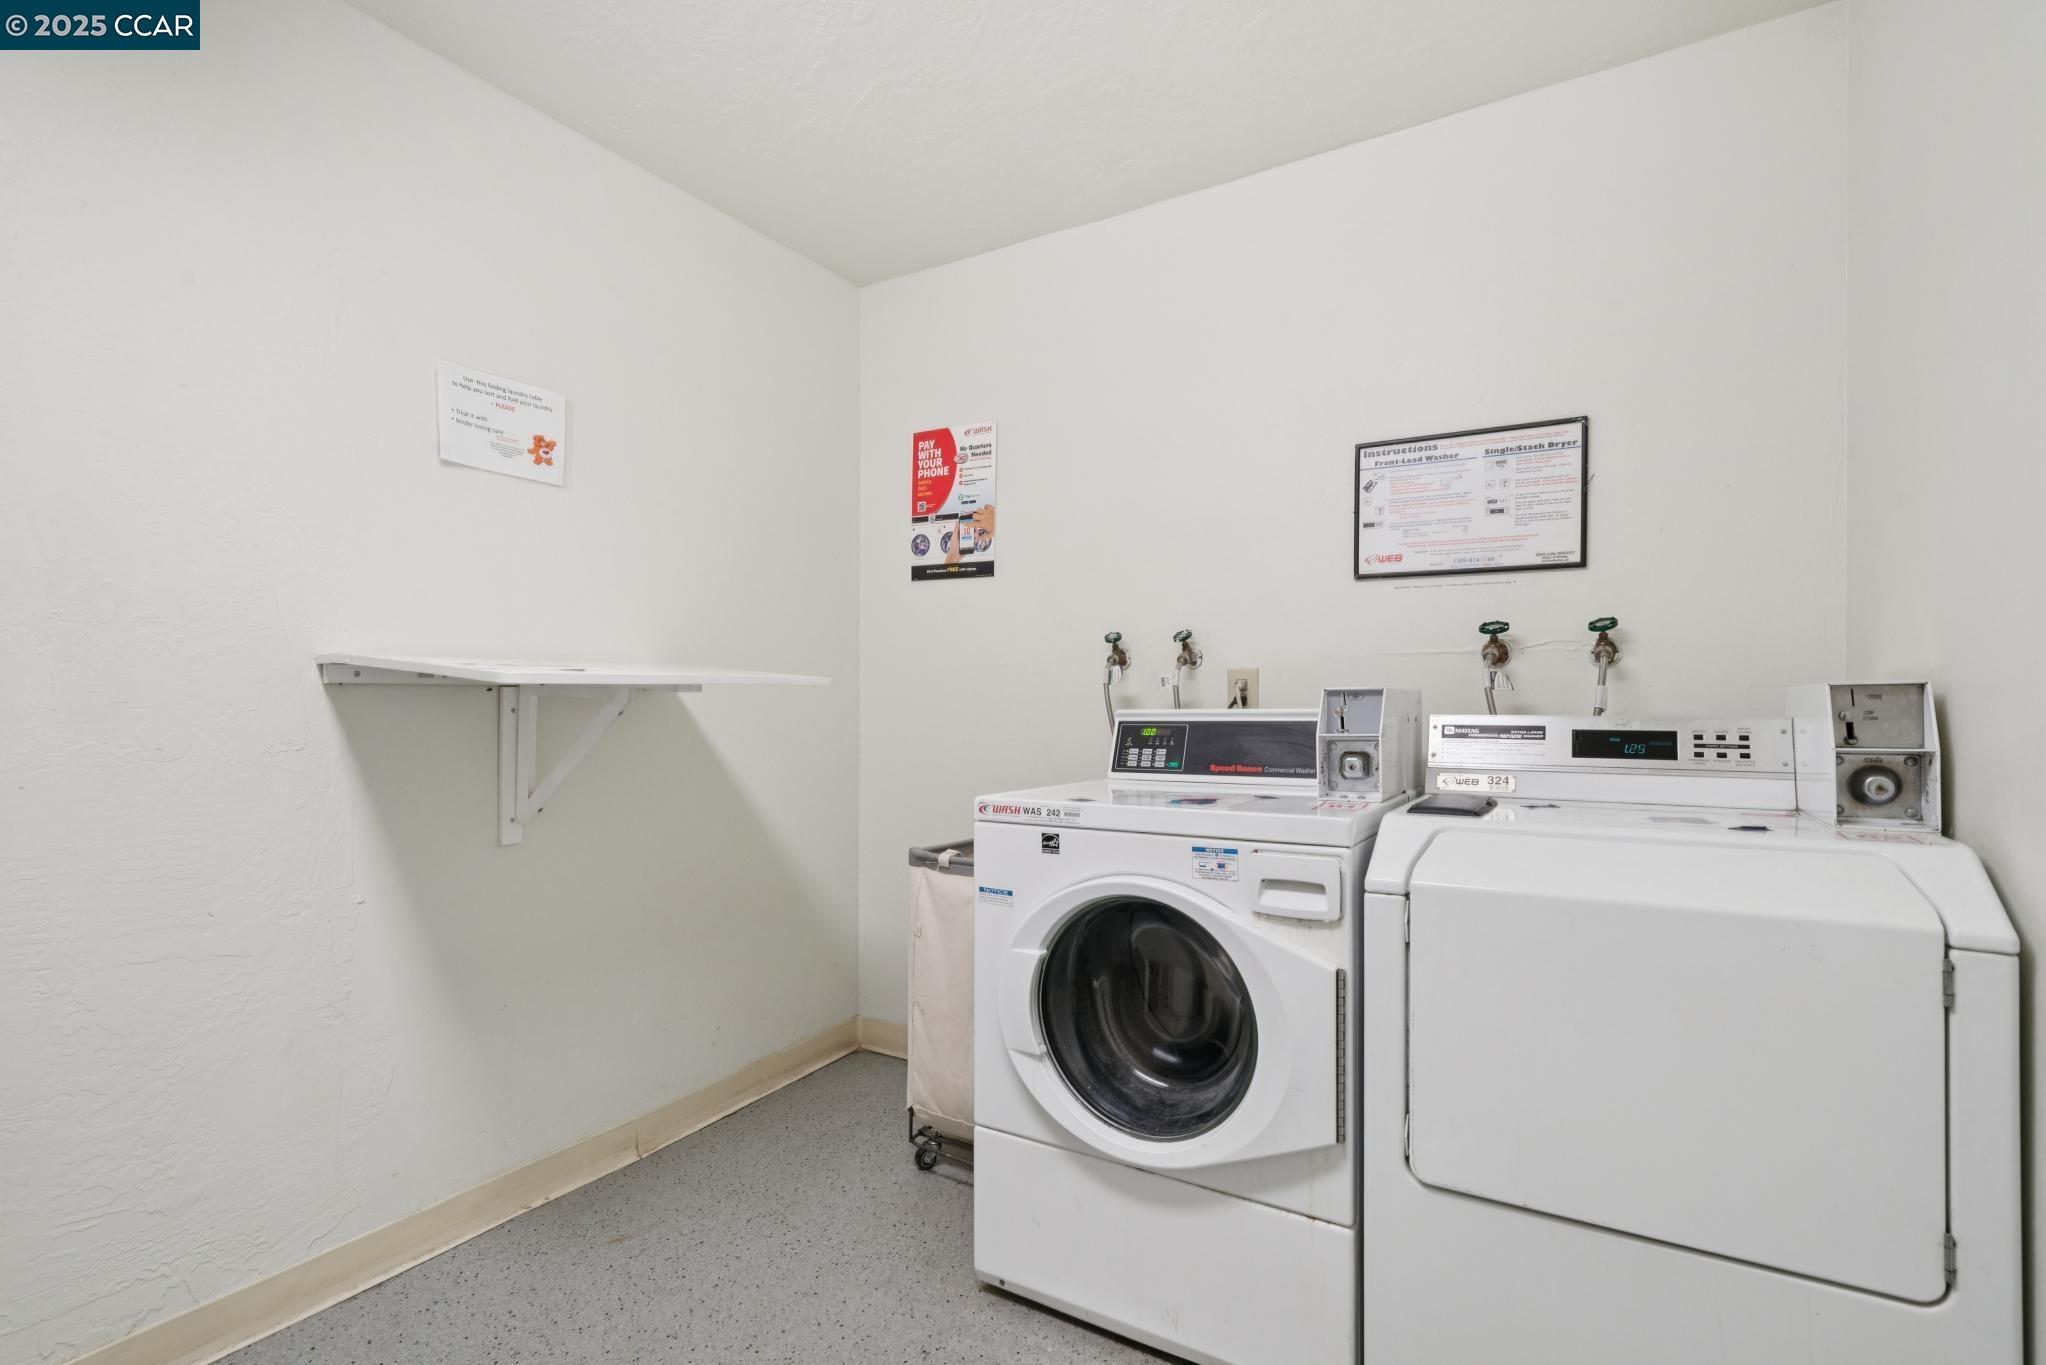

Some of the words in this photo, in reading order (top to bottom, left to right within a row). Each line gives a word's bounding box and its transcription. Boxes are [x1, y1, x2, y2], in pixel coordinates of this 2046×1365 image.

[463, 376, 474, 384] Use
[476, 379, 487, 388] this
[487, 382, 507, 394] folding
[507, 388, 529, 400] laundry
[529, 393, 543, 402] table
[459, 382, 472, 392] help
[473, 387, 484, 395] you
[484, 390, 495, 398] sort
[495, 393, 507, 401] and
[507, 395, 519, 404] fold
[519, 400, 532, 408] your
[532, 401, 553, 413] laundry
[495, 402, 516, 412] PLEASE
[456, 408, 469, 418] Treat
[475, 414, 488, 422] with
[474, 422, 491, 433] loving
[918, 440, 936, 451] PAY
[968, 443, 992, 451] Quarters
[1363, 444, 1439, 458] Instructions
[1484, 443, 1545, 455] Single/Stack
[1547, 440, 1578, 448] Dryer
[918, 448, 942, 460] WITH
[970, 450, 992, 458] Needed
[918, 458, 943, 469] YOUR
[1374, 456, 1423, 467] Front-Load
[1425, 453, 1460, 462] Washer
[918, 466, 950, 480] PHONE
[1378, 553, 1403, 562] WEB
[1209, 764, 1236, 773] Speed
[1236, 764, 1263, 773] Queen
[1295, 766, 1317, 774] Washer
[1455, 778, 1480, 786] WEB
[1487, 776, 1509, 786] 324
[992, 804, 1021, 815] WASH
[1023, 807, 1042, 816] WAS
[1046, 808, 1061, 817] 242
[983, 887, 1009, 895] NOTICE
